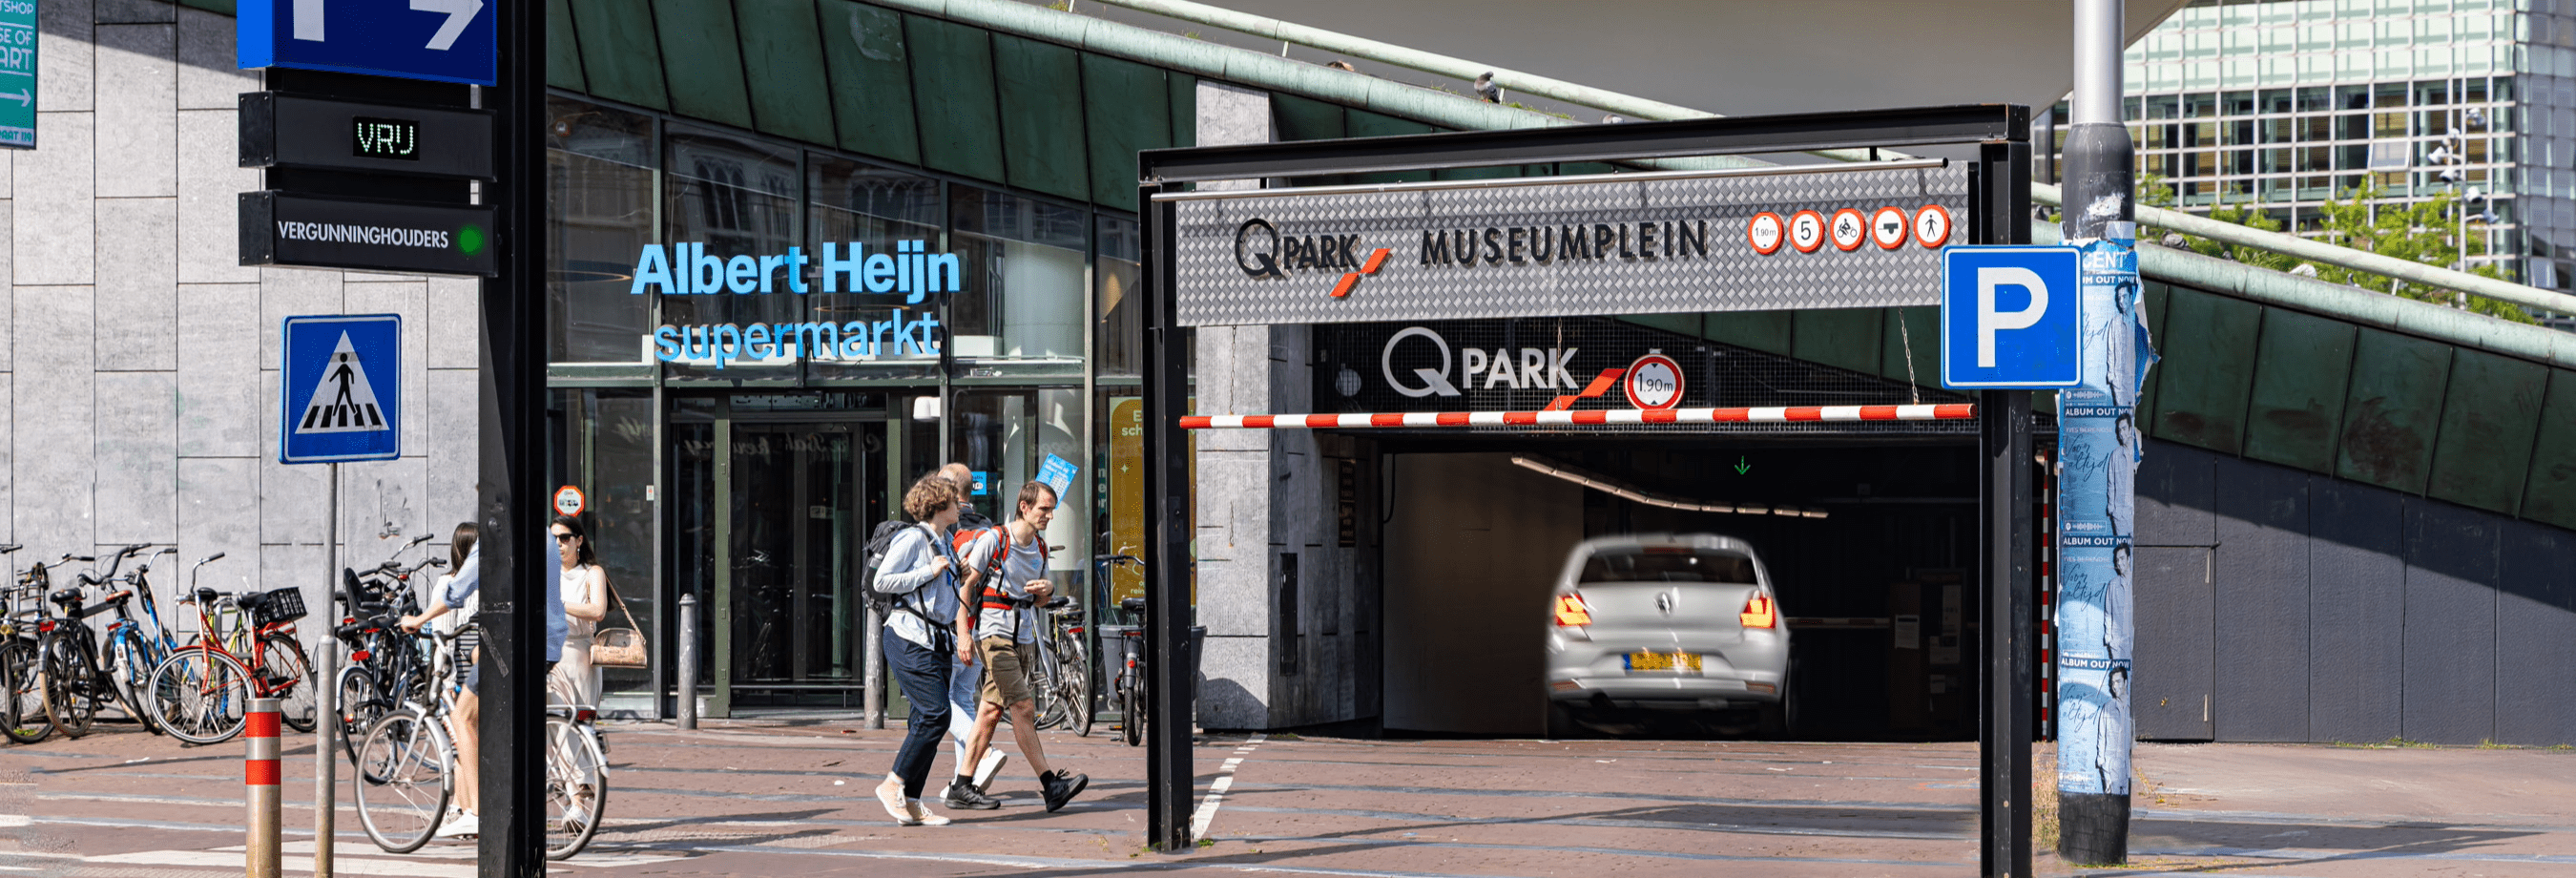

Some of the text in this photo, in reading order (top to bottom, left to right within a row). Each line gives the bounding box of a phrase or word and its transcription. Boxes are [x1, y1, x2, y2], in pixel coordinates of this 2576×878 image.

[14, 30, 33, 46] OF
[278, 220, 449, 249] VERGUNNINGHOUDERS
[1800, 220, 1812, 240] 5
[1421, 220, 1708, 266] MUSEUMPLEIN
[630, 240, 960, 304] Albert Heijn
[2095, 275, 2115, 284] OUT
[1978, 267, 2048, 367] P
[653, 308, 941, 370] supermarkt
[1638, 372, 1673, 392] 1.90m
[2066, 408, 2094, 416] ALBUM
[2096, 408, 2116, 416] OUT
[2063, 536, 2091, 546] ALBUM
[2093, 536, 2114, 546] OUT
[2061, 658, 2088, 667] ALBUM
[2090, 659, 2111, 669] OUT
